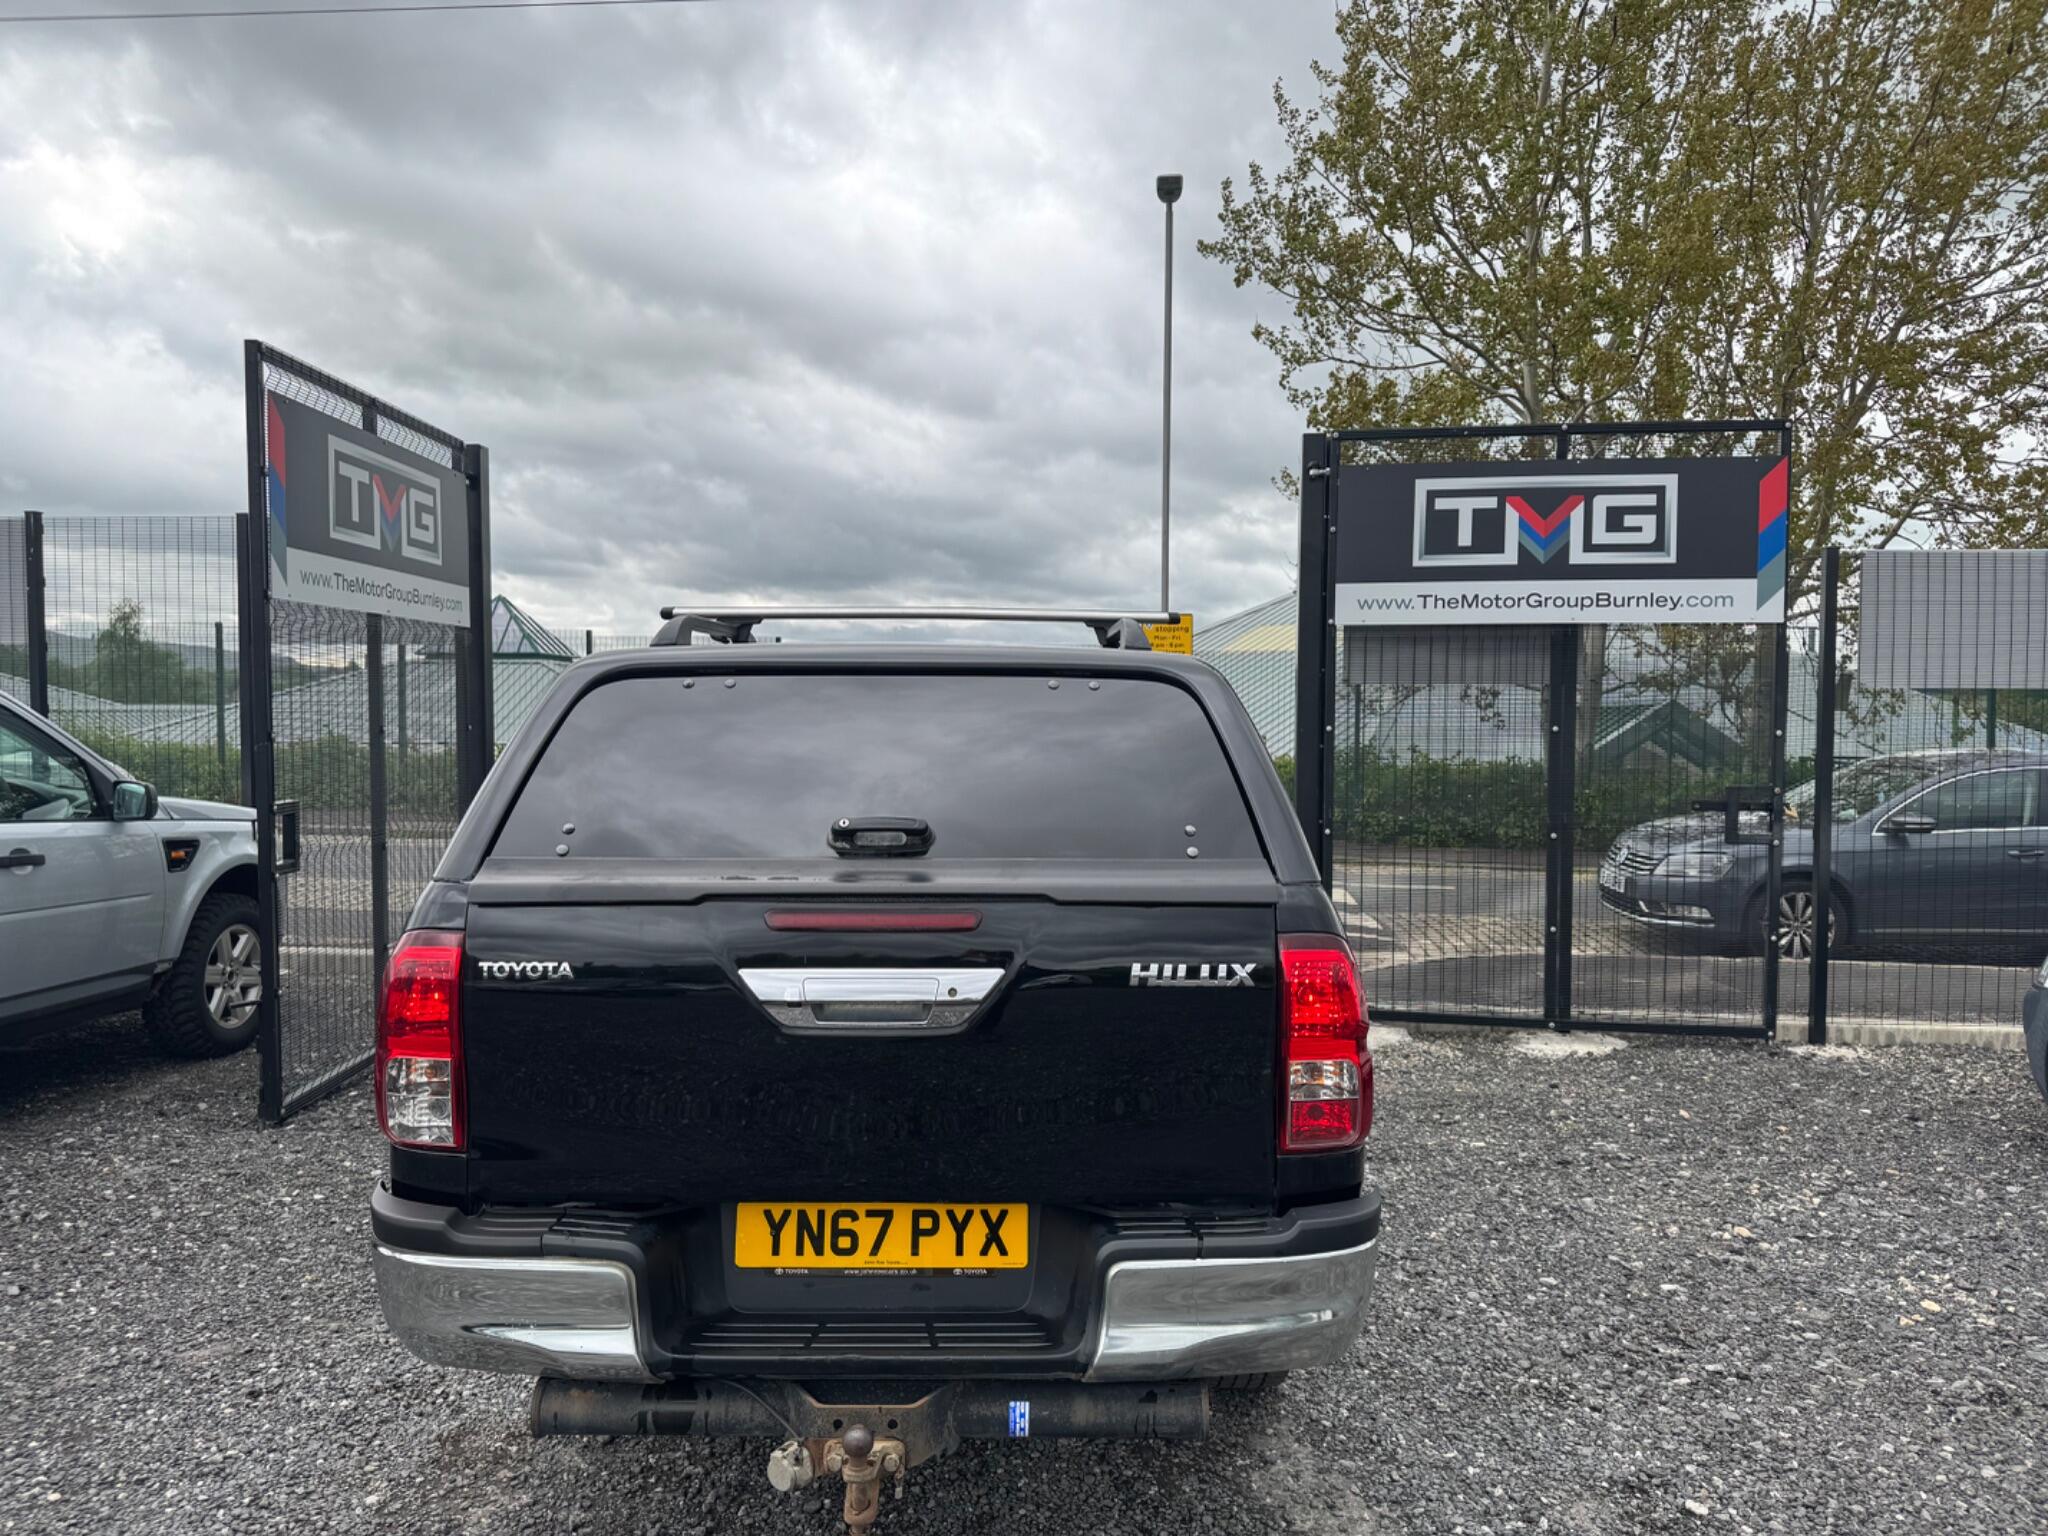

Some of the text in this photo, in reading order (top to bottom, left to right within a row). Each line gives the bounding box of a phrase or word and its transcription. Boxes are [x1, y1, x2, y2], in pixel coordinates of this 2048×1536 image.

[338, 460, 435, 551] TMG
[1434, 494, 1657, 565] TMG
[300, 568, 463, 611] www.TheMotorGroupBurnley.com
[1356, 592, 1735, 611] www.TheMotorGroupBurnley.com
[478, 961, 574, 978] TOYOTA
[1129, 963, 1257, 986] HILUX
[763, 1208, 1009, 1257] YN67 PYX
